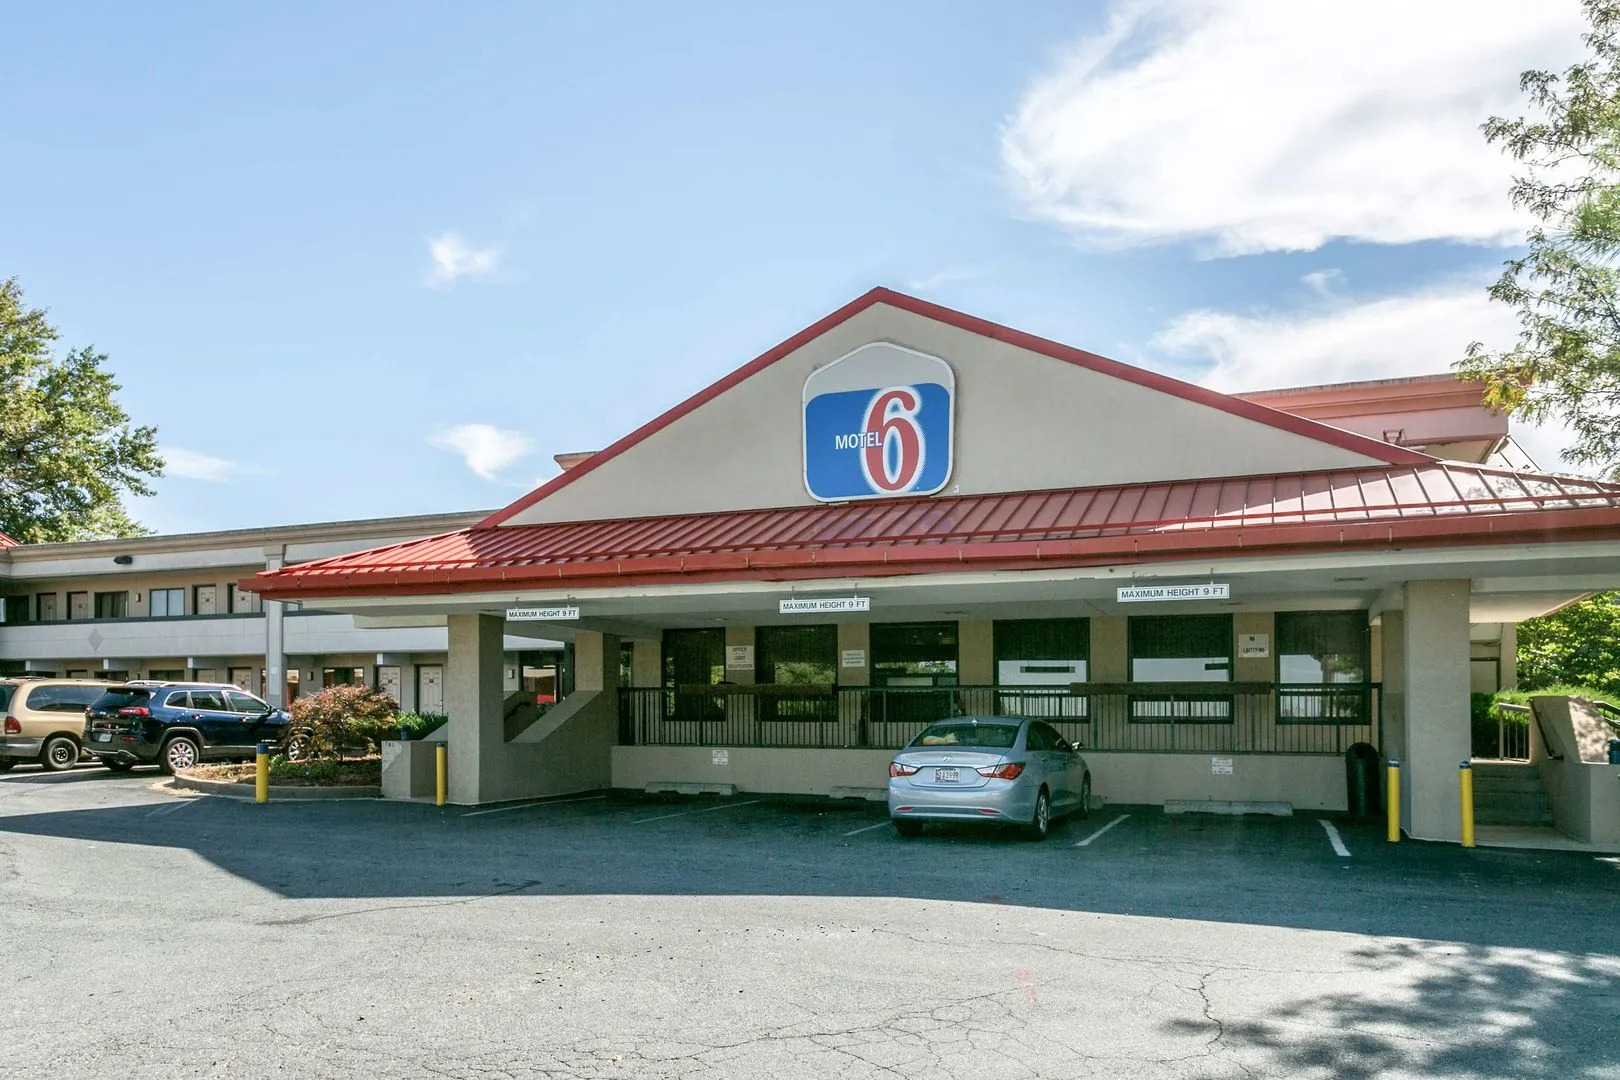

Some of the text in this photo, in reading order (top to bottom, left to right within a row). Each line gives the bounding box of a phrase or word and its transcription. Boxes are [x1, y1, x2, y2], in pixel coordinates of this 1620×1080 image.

[835, 388, 921, 493] MOTEL 6
[1121, 587, 1225, 598] MAXIMUM HEIGHT 9 FT
[782, 600, 866, 610] MAXIMUM HEIGHT 9 FT
